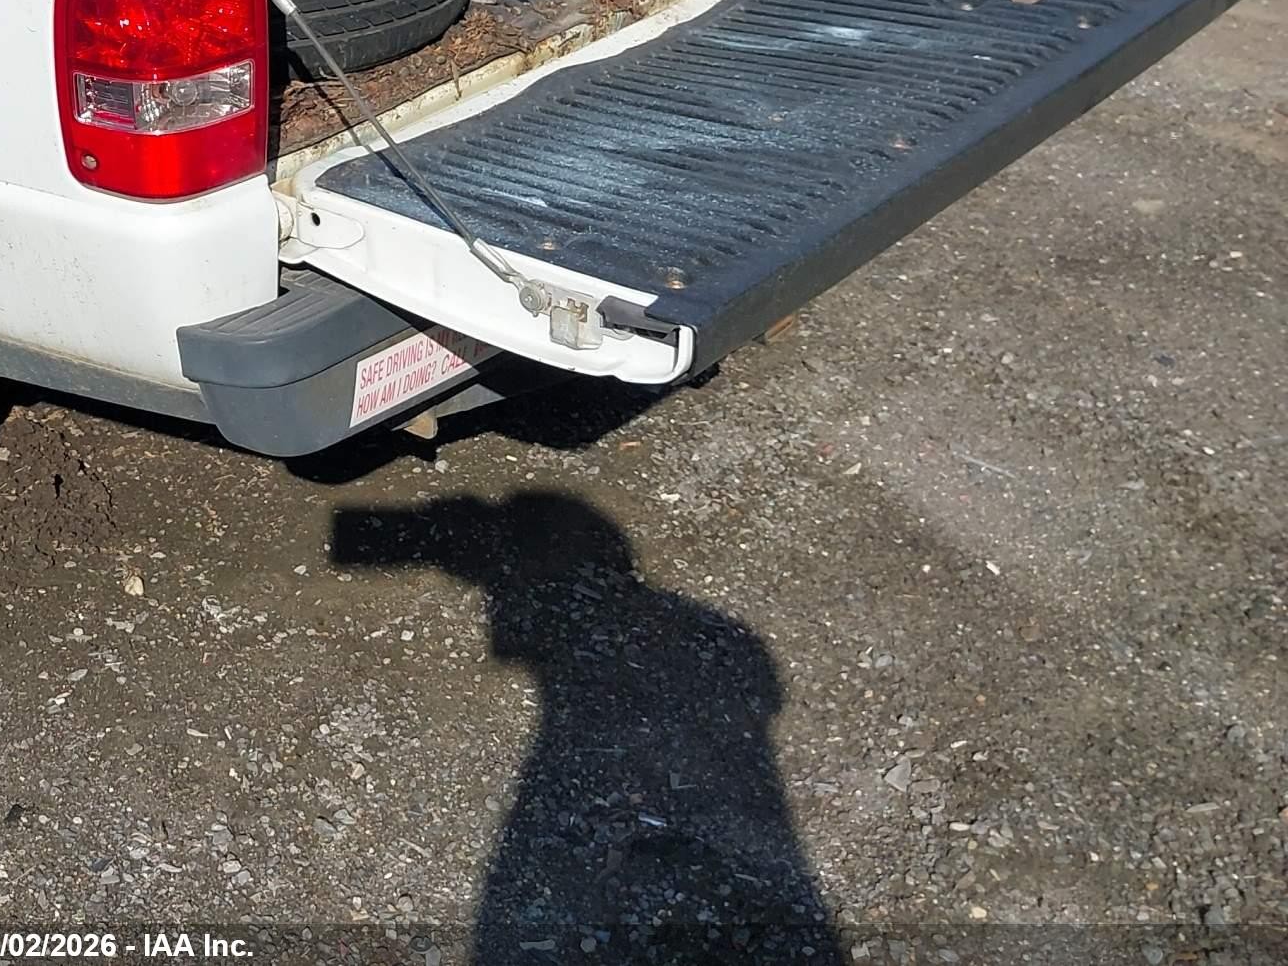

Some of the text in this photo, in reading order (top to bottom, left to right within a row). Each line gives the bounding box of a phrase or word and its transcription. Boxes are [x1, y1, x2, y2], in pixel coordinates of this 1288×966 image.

[356, 391, 379, 418] HOW
[380, 381, 397, 407] AM
[403, 360, 437, 394] DOING?
[360, 360, 384, 390] SAFE
[386, 340, 423, 377] DRIVING
[425, 337, 434, 359] IS
